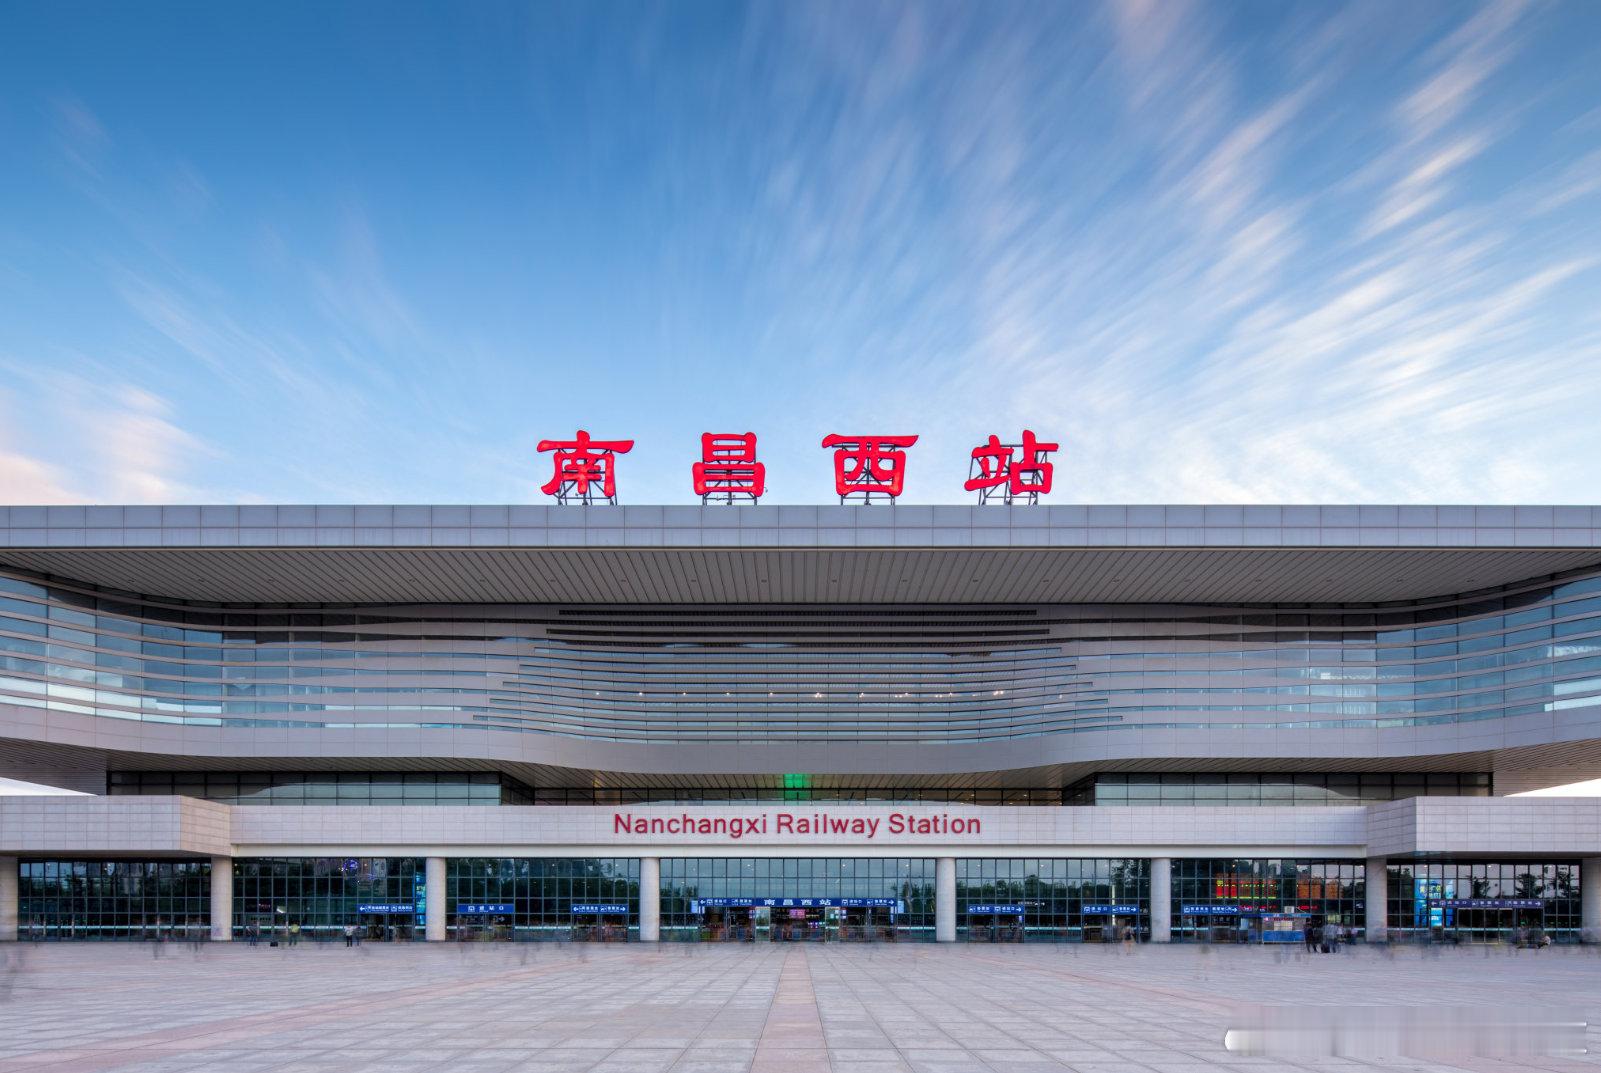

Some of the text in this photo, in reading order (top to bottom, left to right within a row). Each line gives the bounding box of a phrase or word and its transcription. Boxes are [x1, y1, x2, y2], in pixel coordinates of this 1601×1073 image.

[537, 430, 1058, 497] 南昌西站
[614, 813, 981, 839] Nanchangxi Railway Station
[763, 898, 832, 906] 南昌西站
